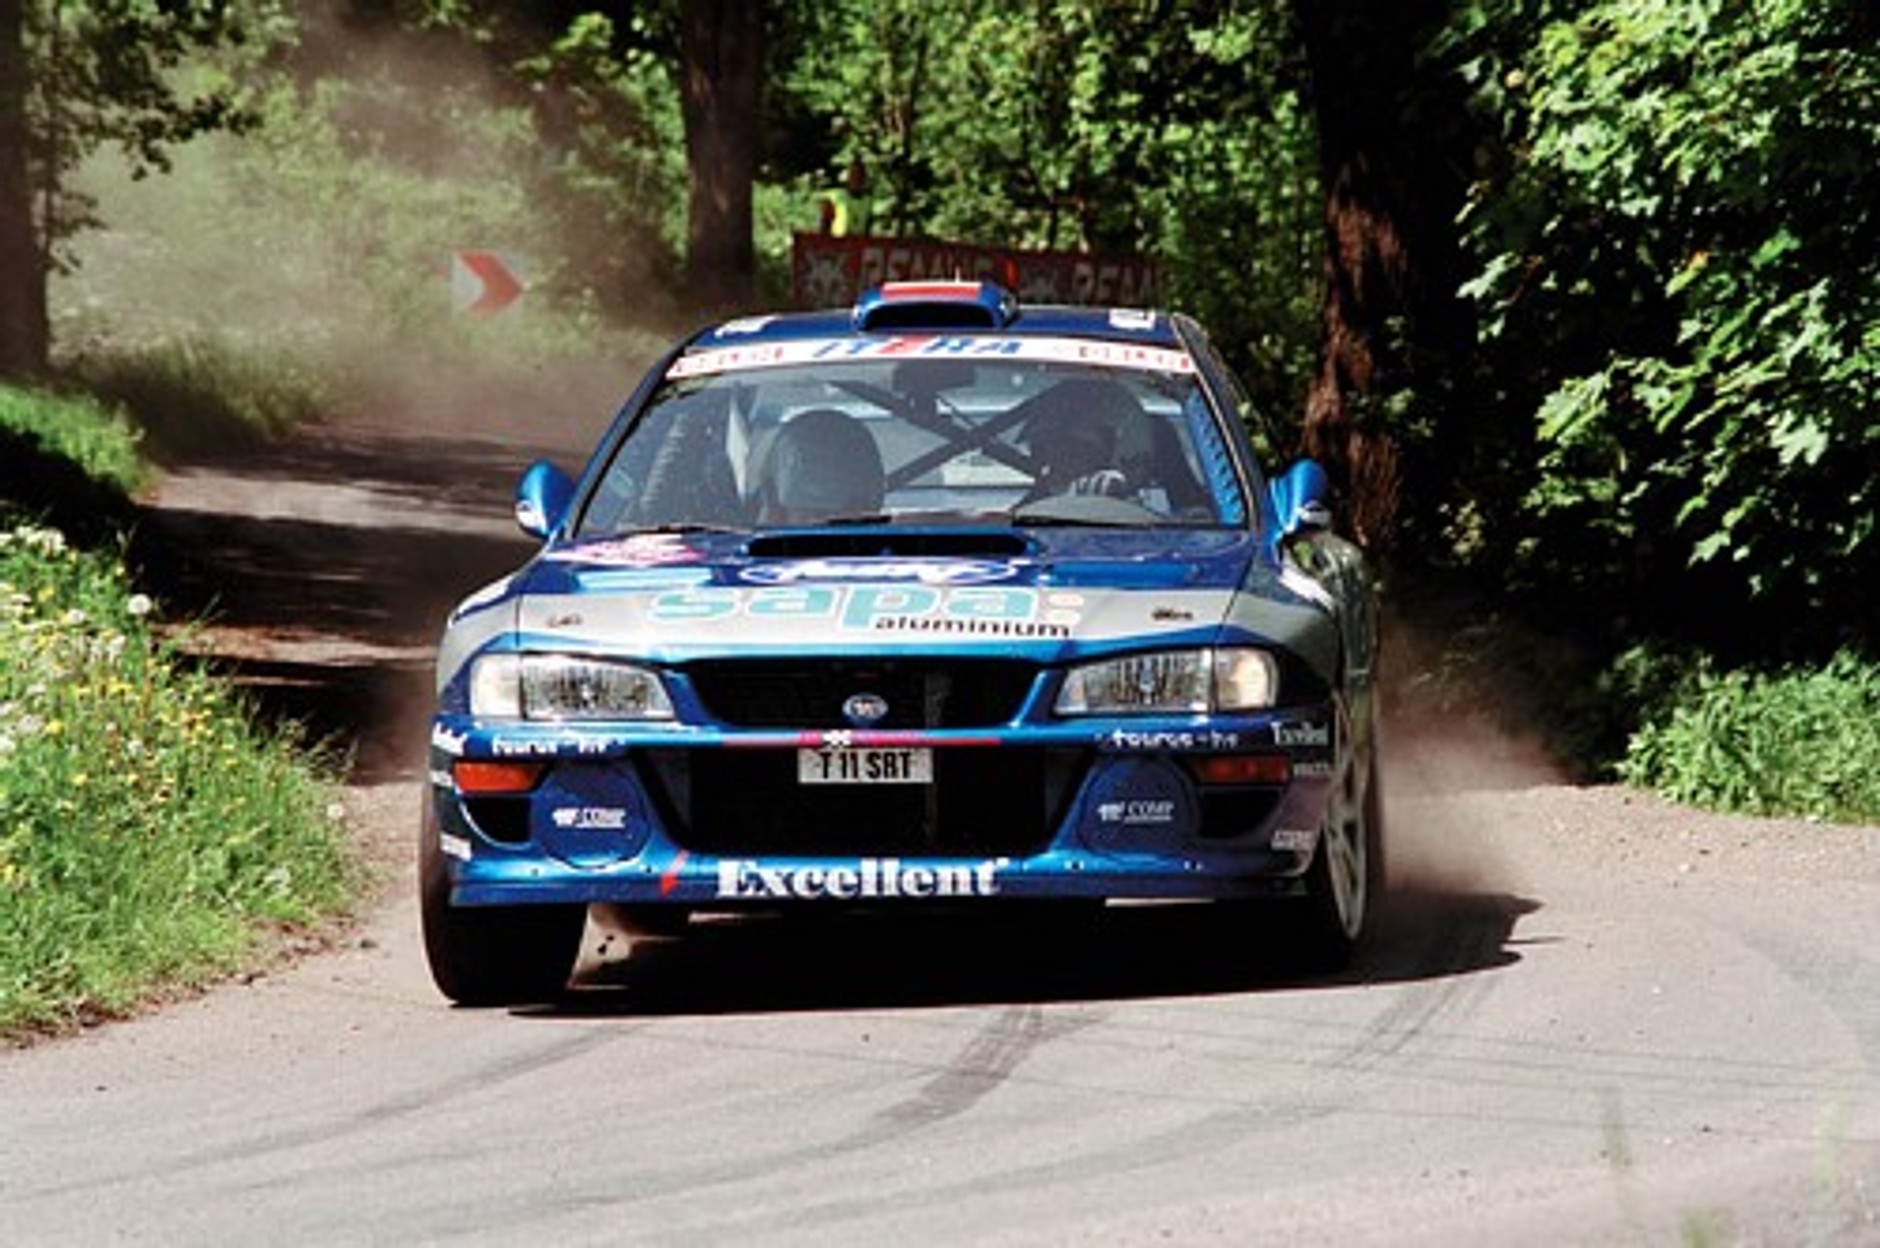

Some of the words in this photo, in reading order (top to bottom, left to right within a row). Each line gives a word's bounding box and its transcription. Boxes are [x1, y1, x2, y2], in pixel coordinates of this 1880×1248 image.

[875, 616, 1071, 638] aluminium
[866, 751, 911, 779] SRT
[716, 857, 1000, 898] Excellent
